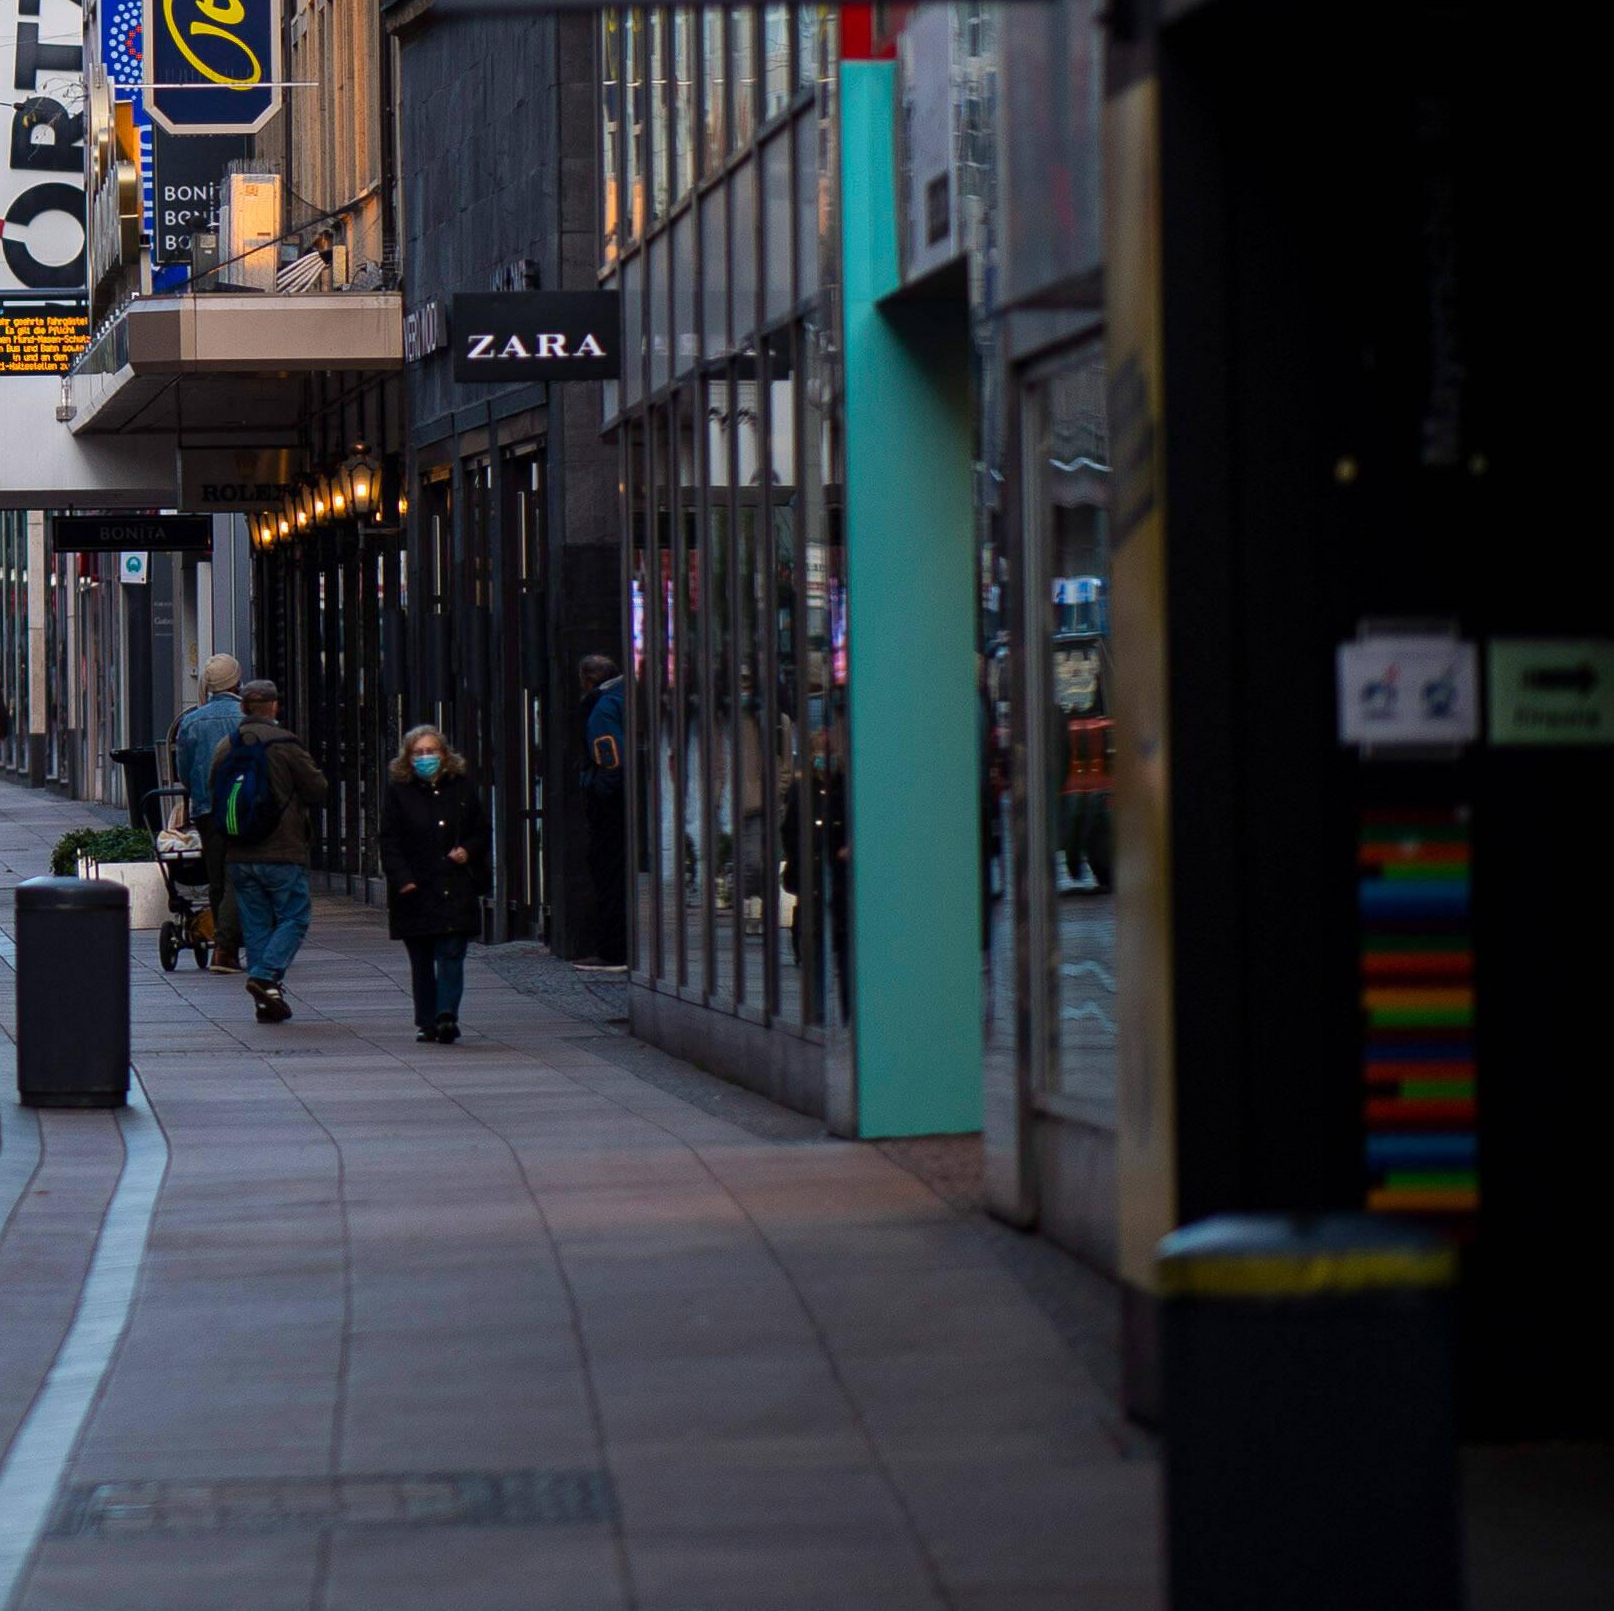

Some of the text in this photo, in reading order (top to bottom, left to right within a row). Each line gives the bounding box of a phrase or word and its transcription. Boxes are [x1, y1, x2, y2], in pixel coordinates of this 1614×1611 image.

[23, 344, 38, 353] und
[467, 333, 607, 359] ZARA
[23, 353, 38, 362] und
